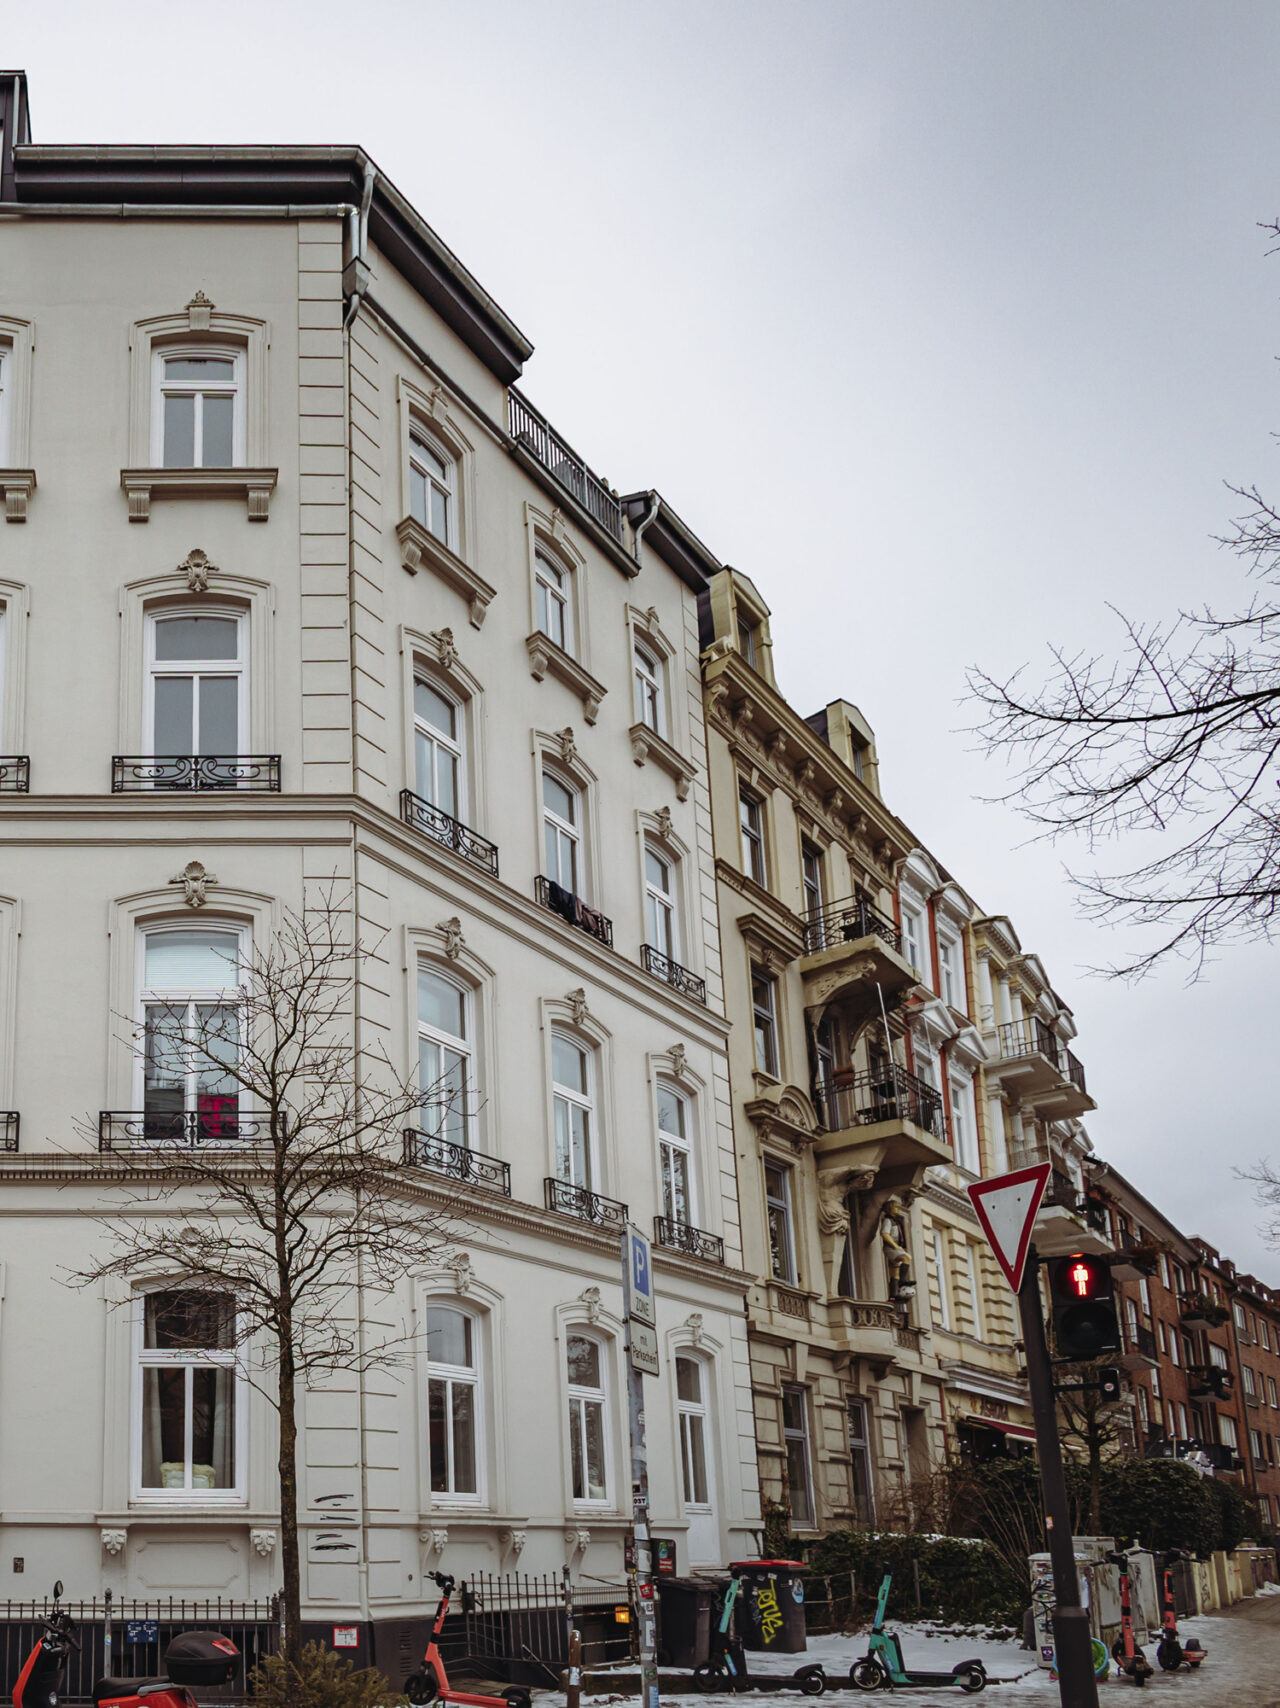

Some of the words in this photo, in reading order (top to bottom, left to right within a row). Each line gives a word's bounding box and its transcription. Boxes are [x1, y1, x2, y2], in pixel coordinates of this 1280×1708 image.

[635, 1244, 645, 1284] P
[635, 1297, 650, 1317] ZONE
[632, 1344, 657, 1366] Parkschein
